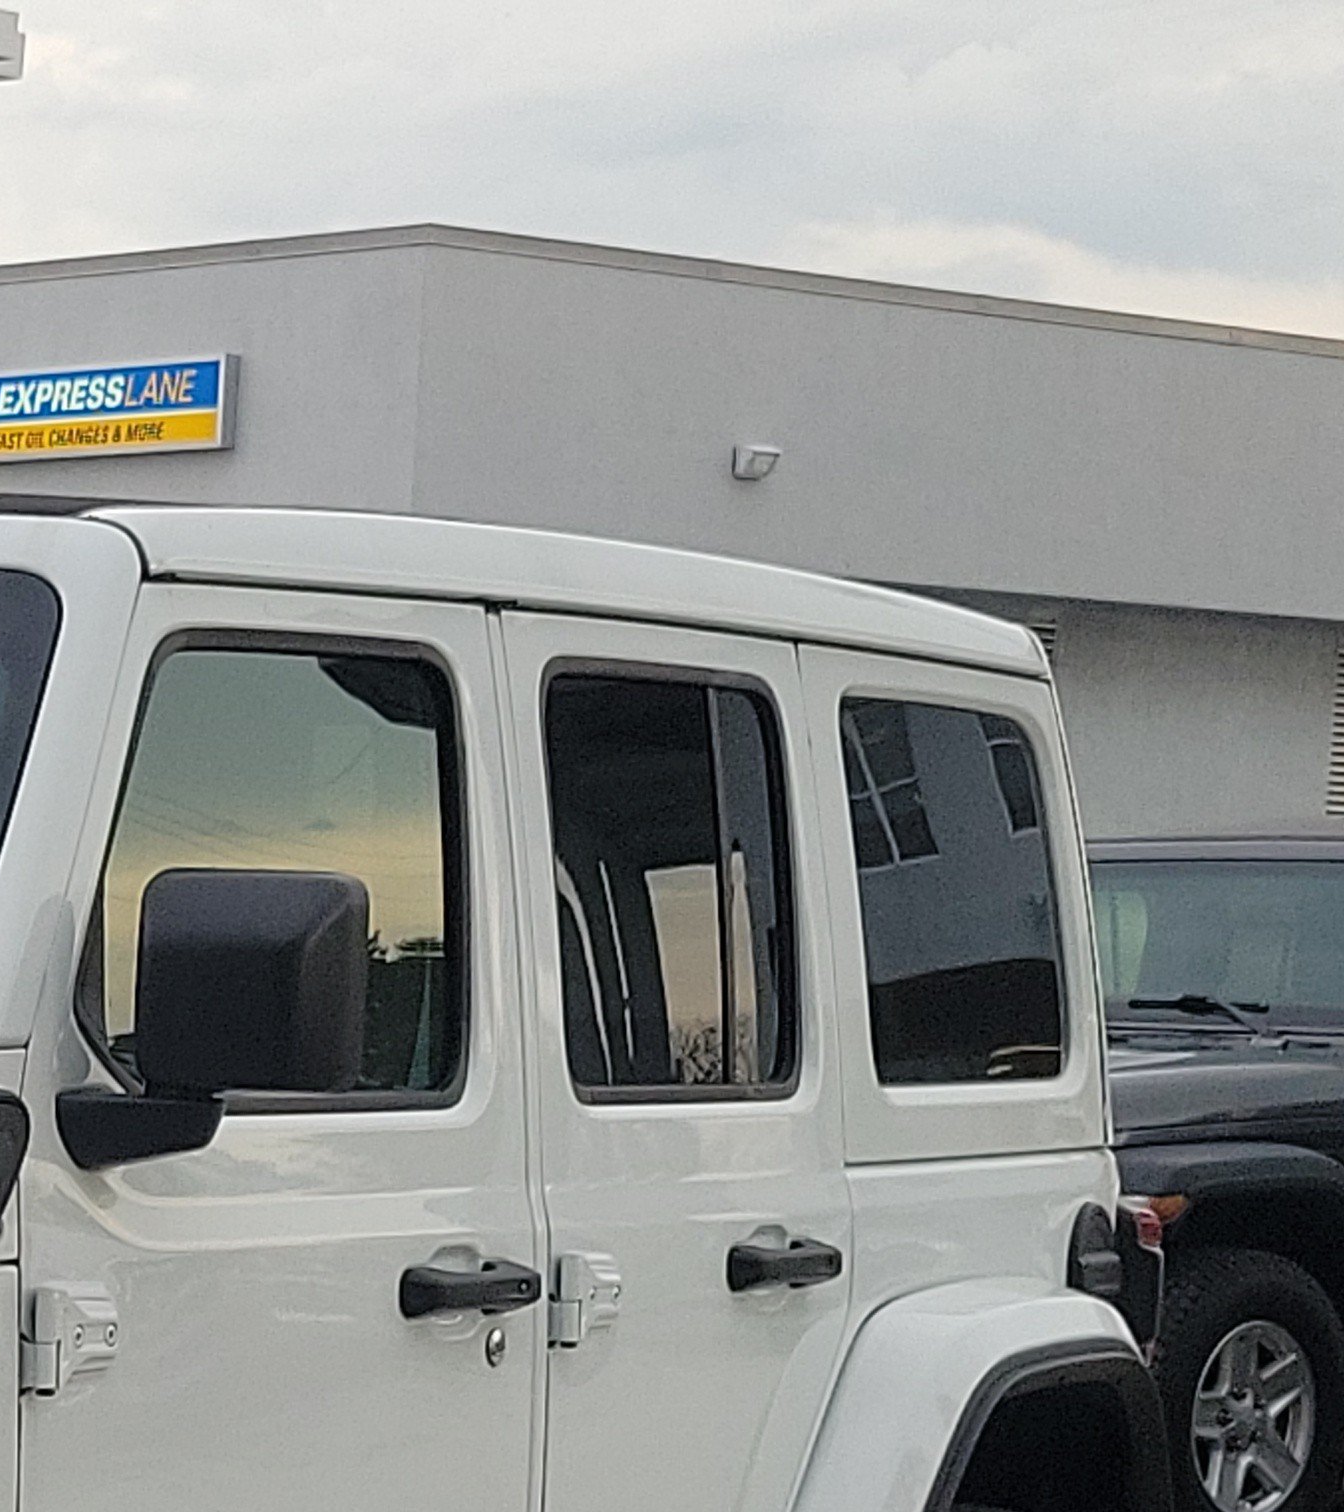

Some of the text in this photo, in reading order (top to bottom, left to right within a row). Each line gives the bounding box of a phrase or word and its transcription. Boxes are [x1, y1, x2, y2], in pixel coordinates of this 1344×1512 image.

[25, 429, 45, 449] OIL
[48, 425, 109, 448] CHANGES
[112, 425, 122, 443] &
[124, 421, 165, 443] MORE
